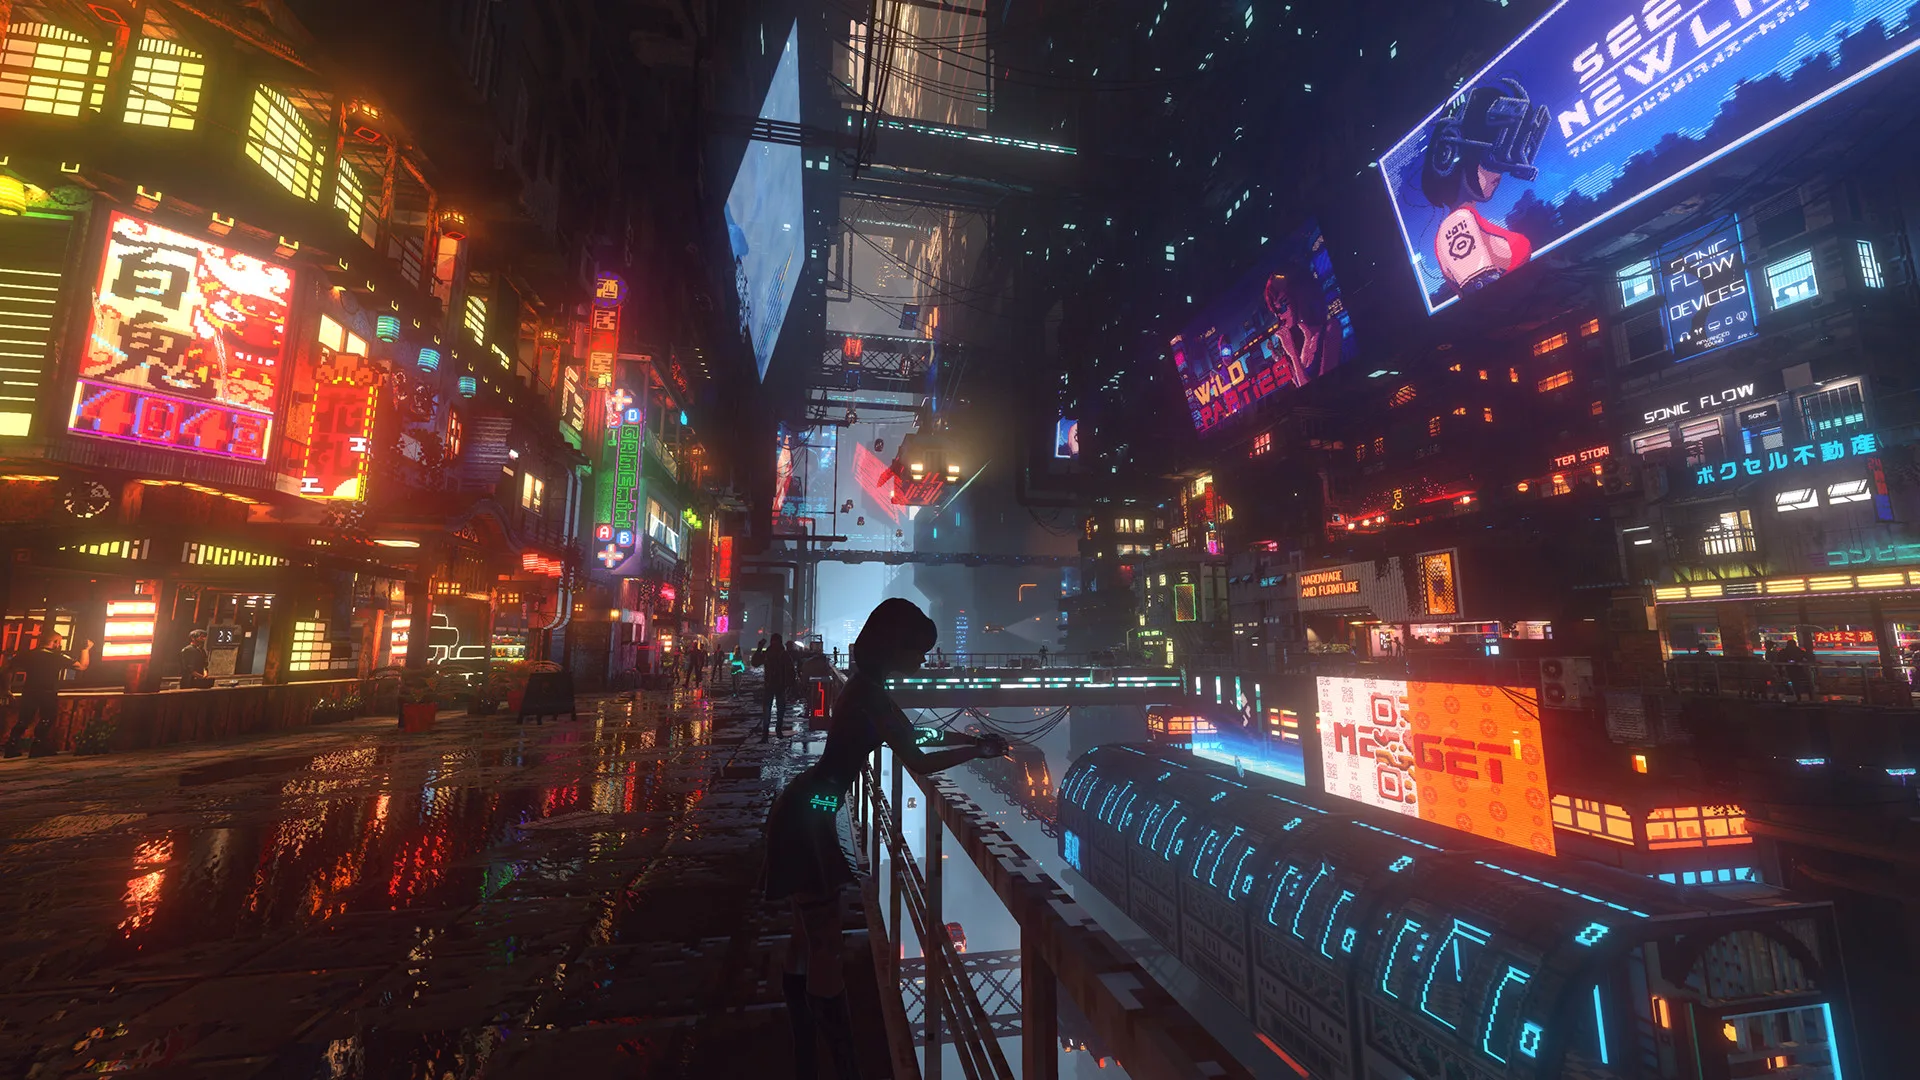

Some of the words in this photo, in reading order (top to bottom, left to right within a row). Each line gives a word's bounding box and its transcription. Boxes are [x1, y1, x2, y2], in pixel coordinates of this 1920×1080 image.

[1557, 31, 1677, 139] NEW
[1670, 253, 1734, 293] FLOW
[1670, 279, 1746, 321] DEVICES
[1644, 402, 1690, 424] SONIC
[1700, 383, 1754, 408] FLOW
[1555, 454, 1576, 467] TEA
[1697, 432, 1877, 485] ボクセル不動産
[1301, 570, 1342, 585] HARDWARE
[1302, 587, 1317, 598] AND
[1318, 581, 1359, 596] FURNITURE
